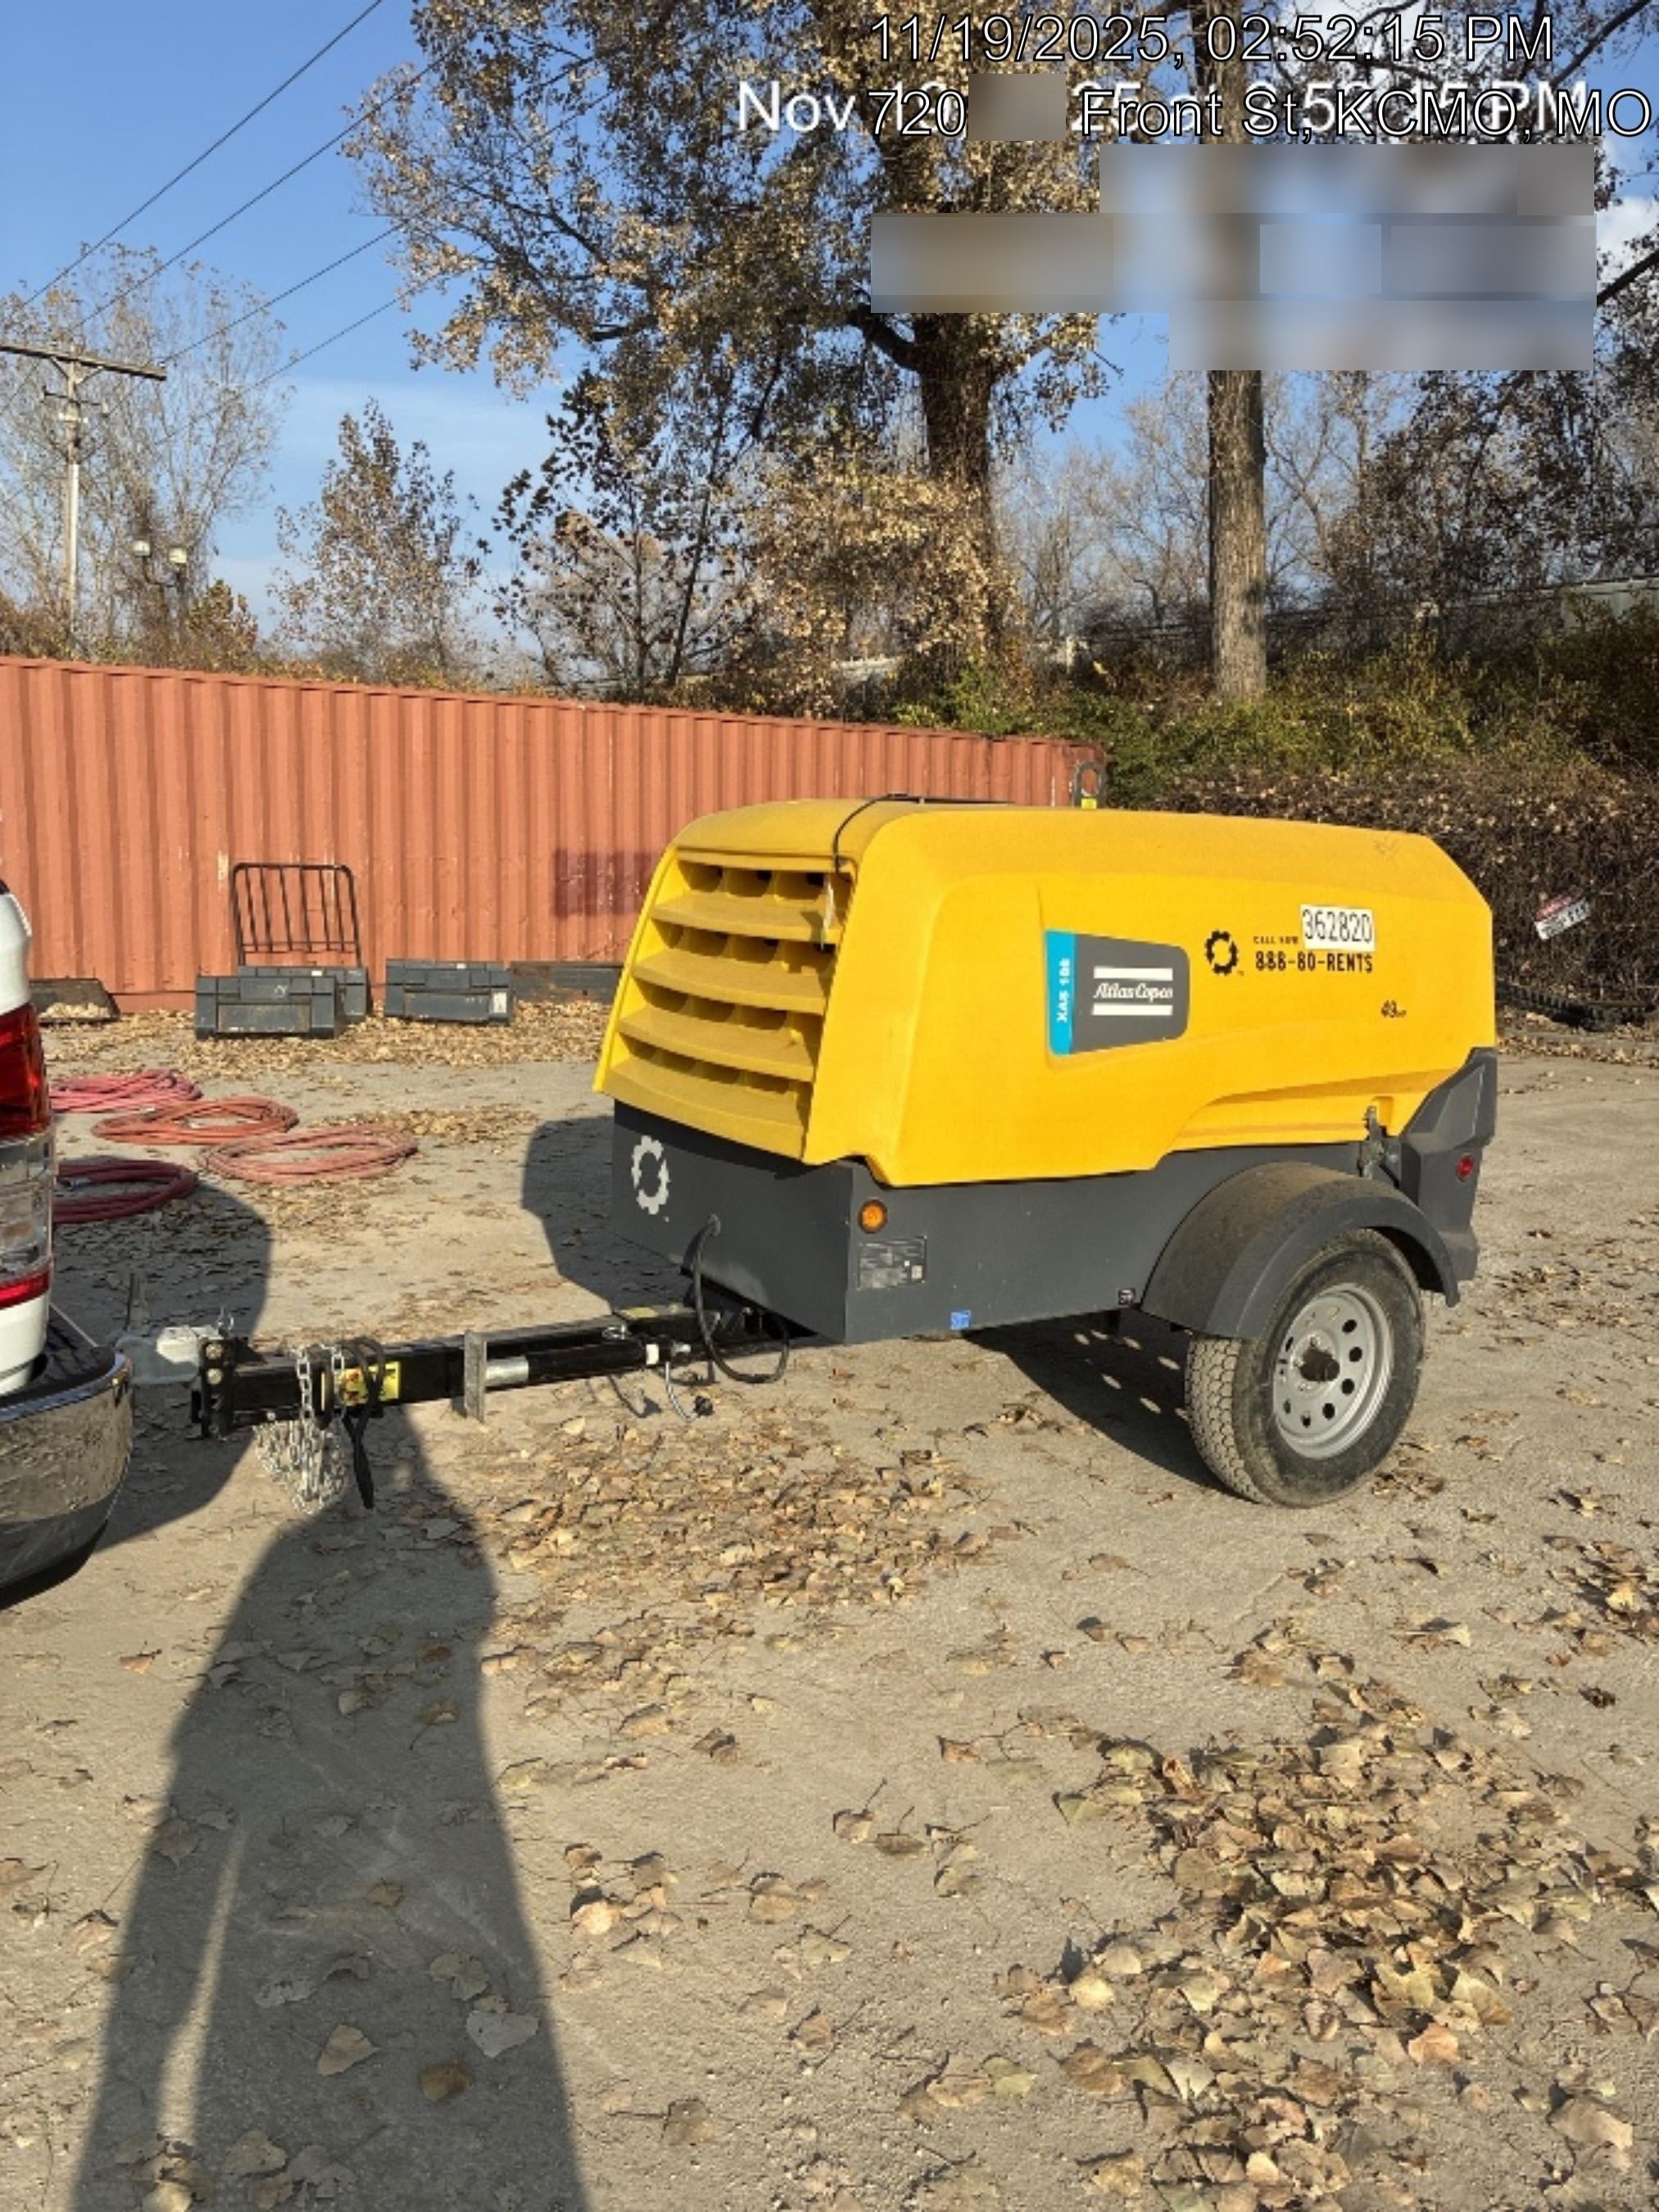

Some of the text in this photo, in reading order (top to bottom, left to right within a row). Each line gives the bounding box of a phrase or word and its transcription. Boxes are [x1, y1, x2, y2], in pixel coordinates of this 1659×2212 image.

[1303, 909, 1374, 943] 362820
[1092, 982, 1173, 1004] Atlas Copco
